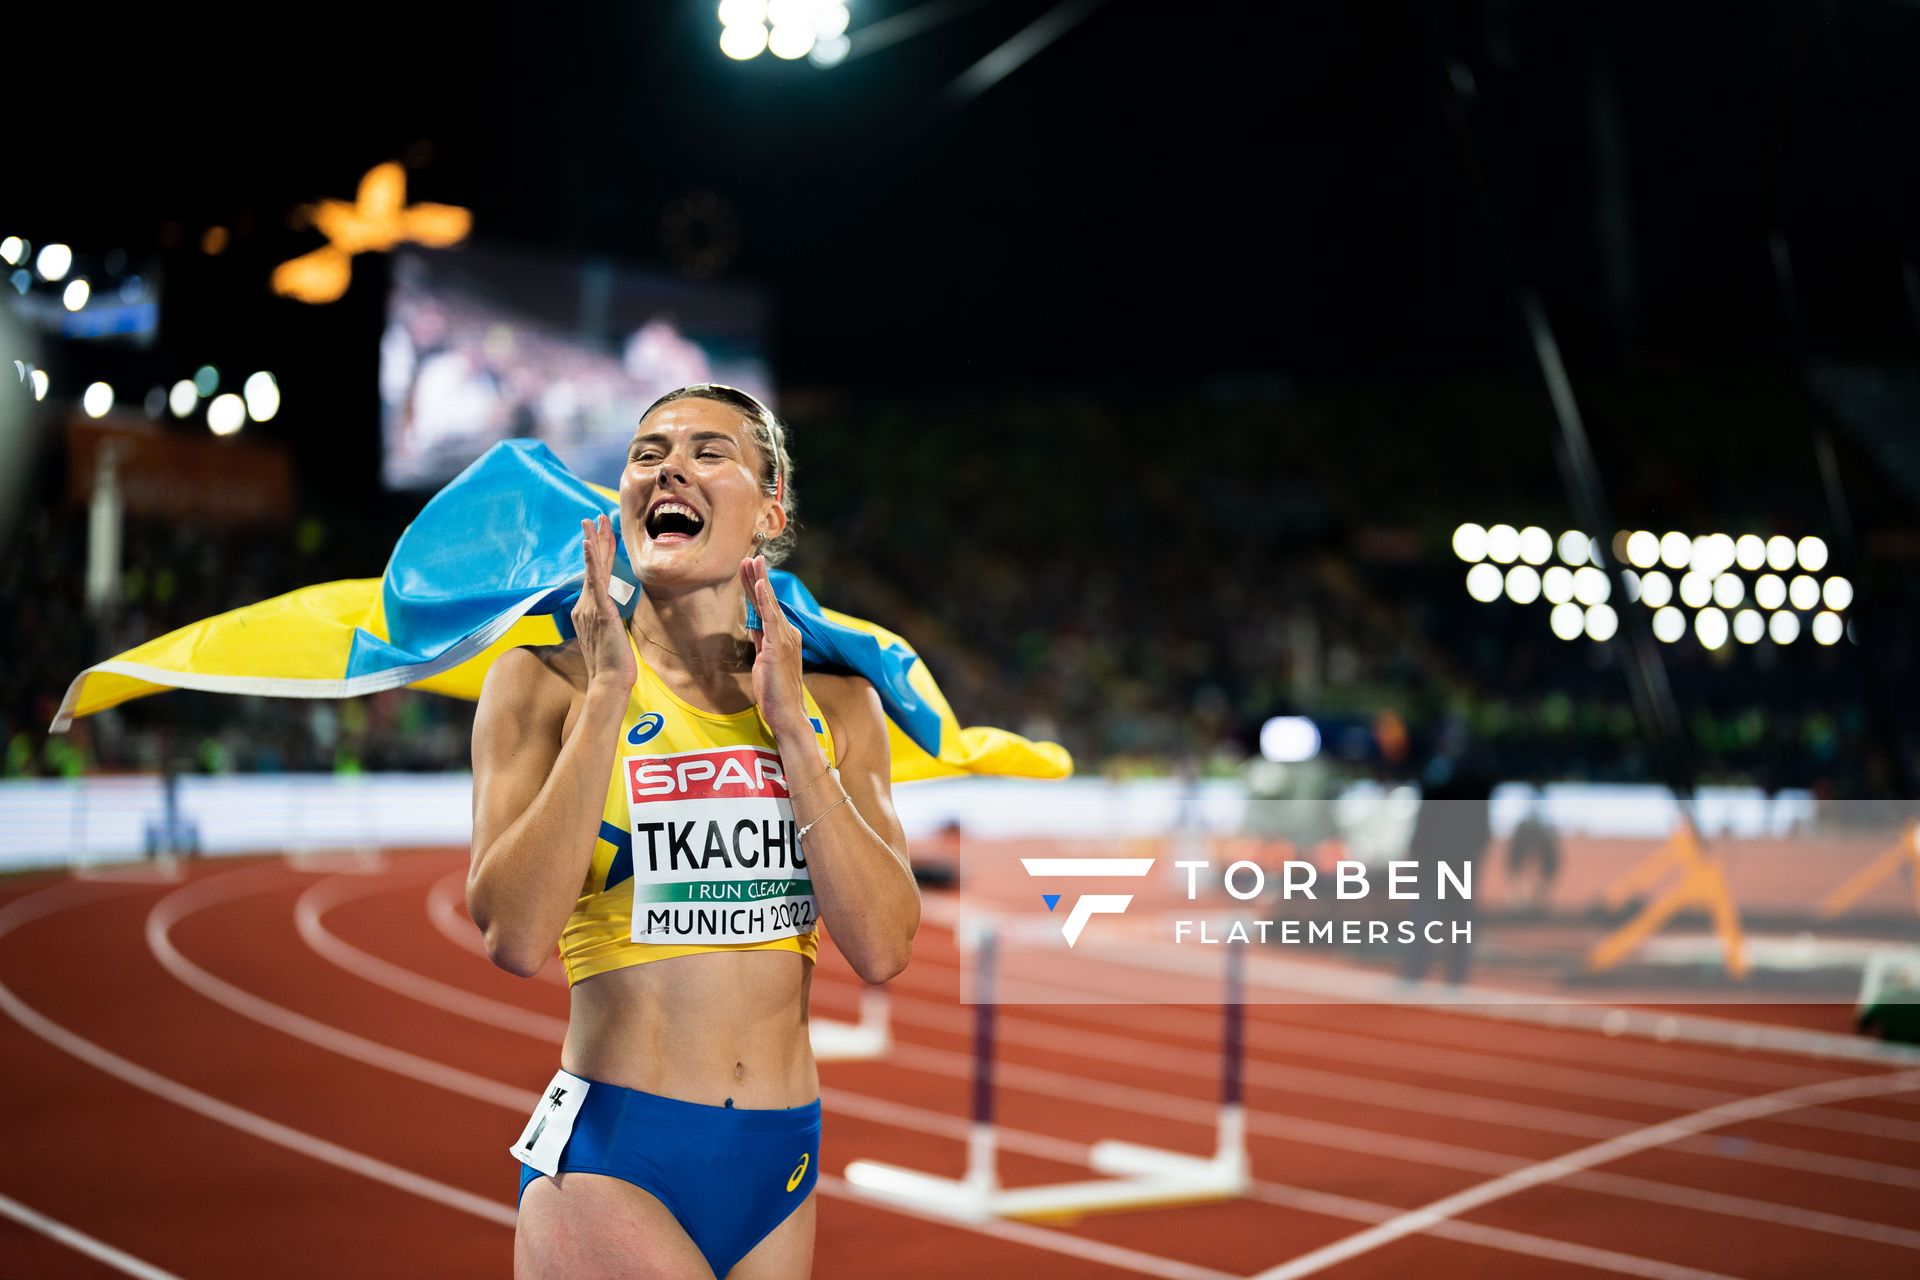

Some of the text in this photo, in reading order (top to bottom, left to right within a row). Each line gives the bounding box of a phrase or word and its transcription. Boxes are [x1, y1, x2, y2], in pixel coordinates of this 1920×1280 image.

[635, 757, 788, 796] SPAR
[637, 818, 808, 871] TKACHU
[688, 884, 693, 899] I
[699, 884, 741, 899] RUN
[647, 900, 811, 935] MUNICH 2022
